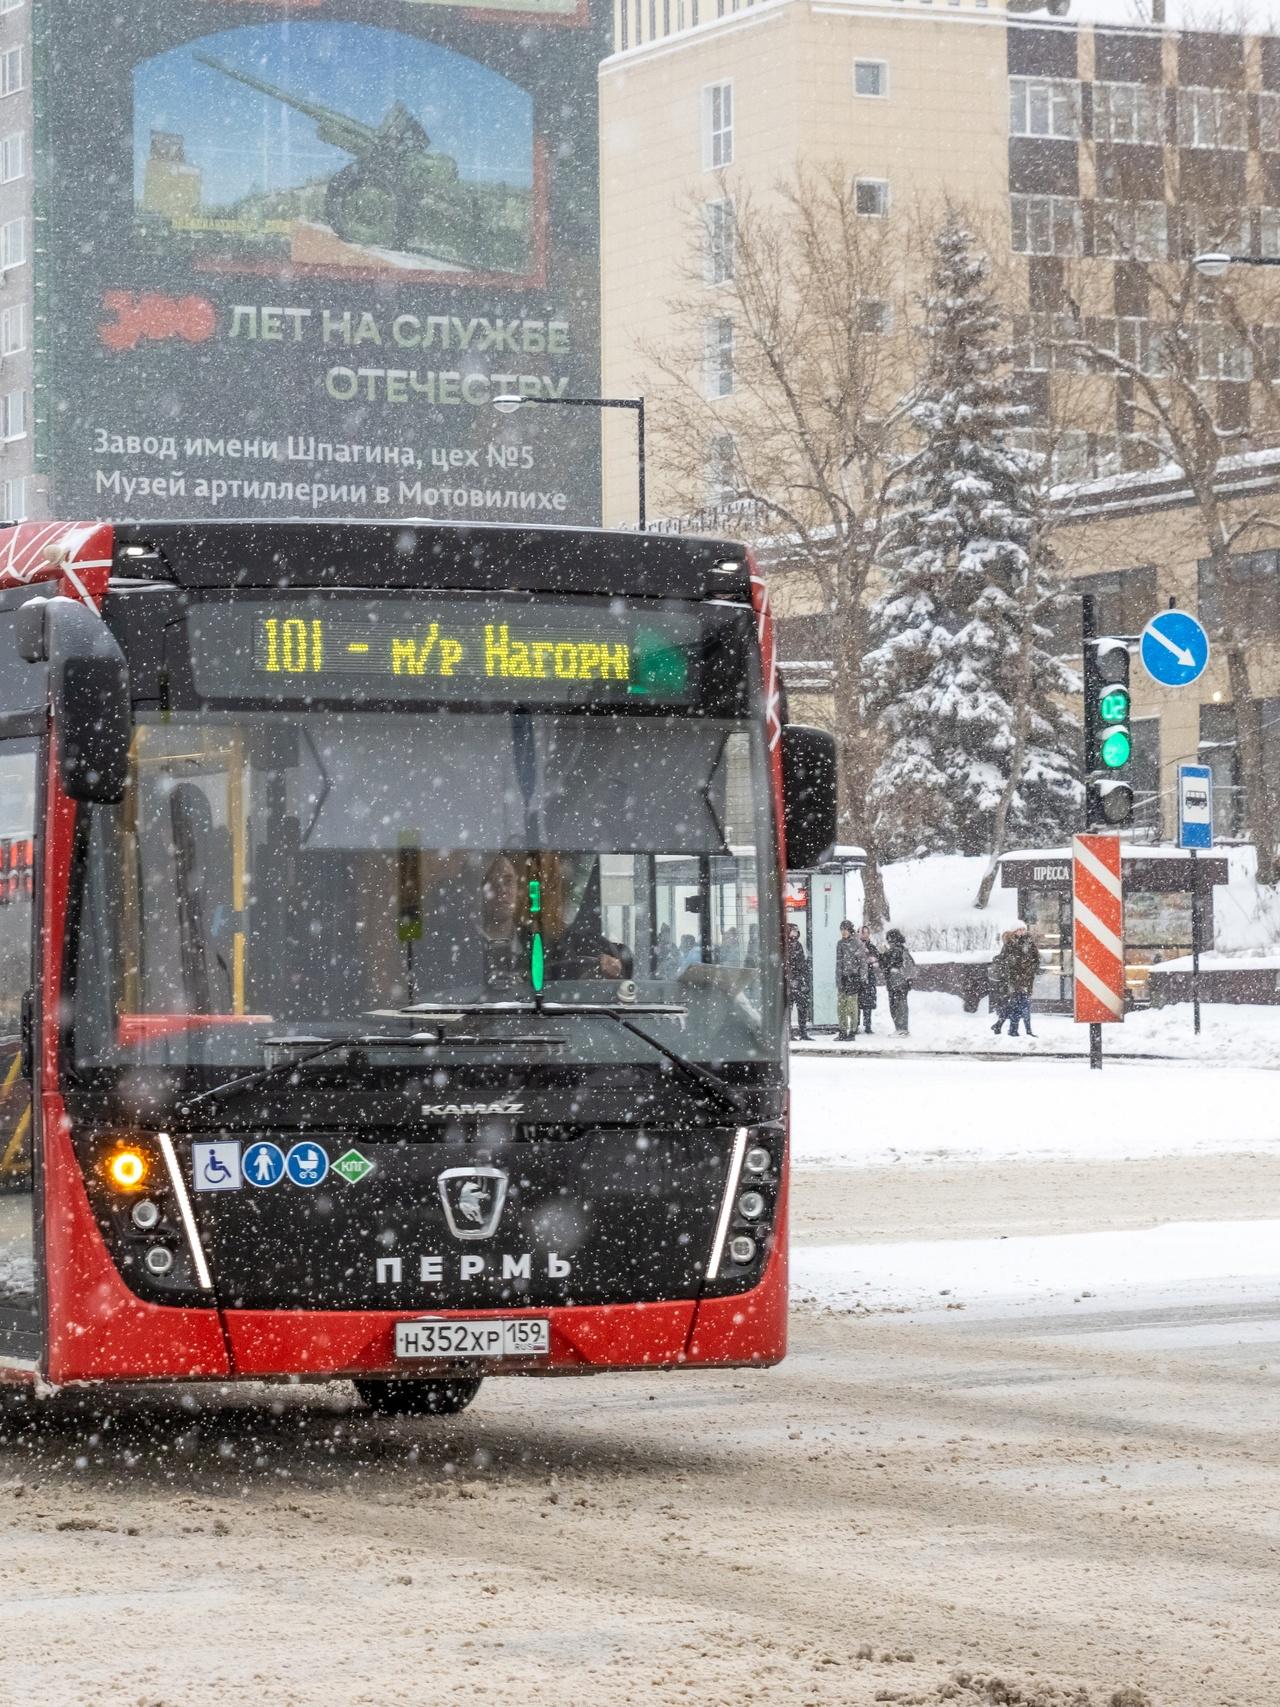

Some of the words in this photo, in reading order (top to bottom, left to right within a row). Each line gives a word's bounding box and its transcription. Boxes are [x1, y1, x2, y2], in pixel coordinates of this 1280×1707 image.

[228, 305, 312, 342] ЛЕТ
[322, 310, 382, 347] НА
[392, 313, 570, 355] СЛУЖБЕ
[325, 365, 569, 410] ОТЕЧЕСТВУ
[94, 428, 178, 460] Завод
[185, 437, 278, 459] имени
[287, 435, 423, 470] Шпагина,
[431, 447, 480, 472] цех
[487, 443, 535, 470] №5
[95, 470, 186, 502] Музей
[194, 477, 367, 509] артиллерии
[376, 485, 391, 504] в
[398, 481, 568, 511] Мотовилихе
[391, 622, 463, 676] м/р
[1102, 695, 1126, 720] 02
[1033, 866, 1070, 880] ПРЕССА
[421, 1103, 525, 1116] KAMAZ
[375, 1252, 571, 1284] ПЕРМЬ
[506, 1322, 541, 1343] 159
